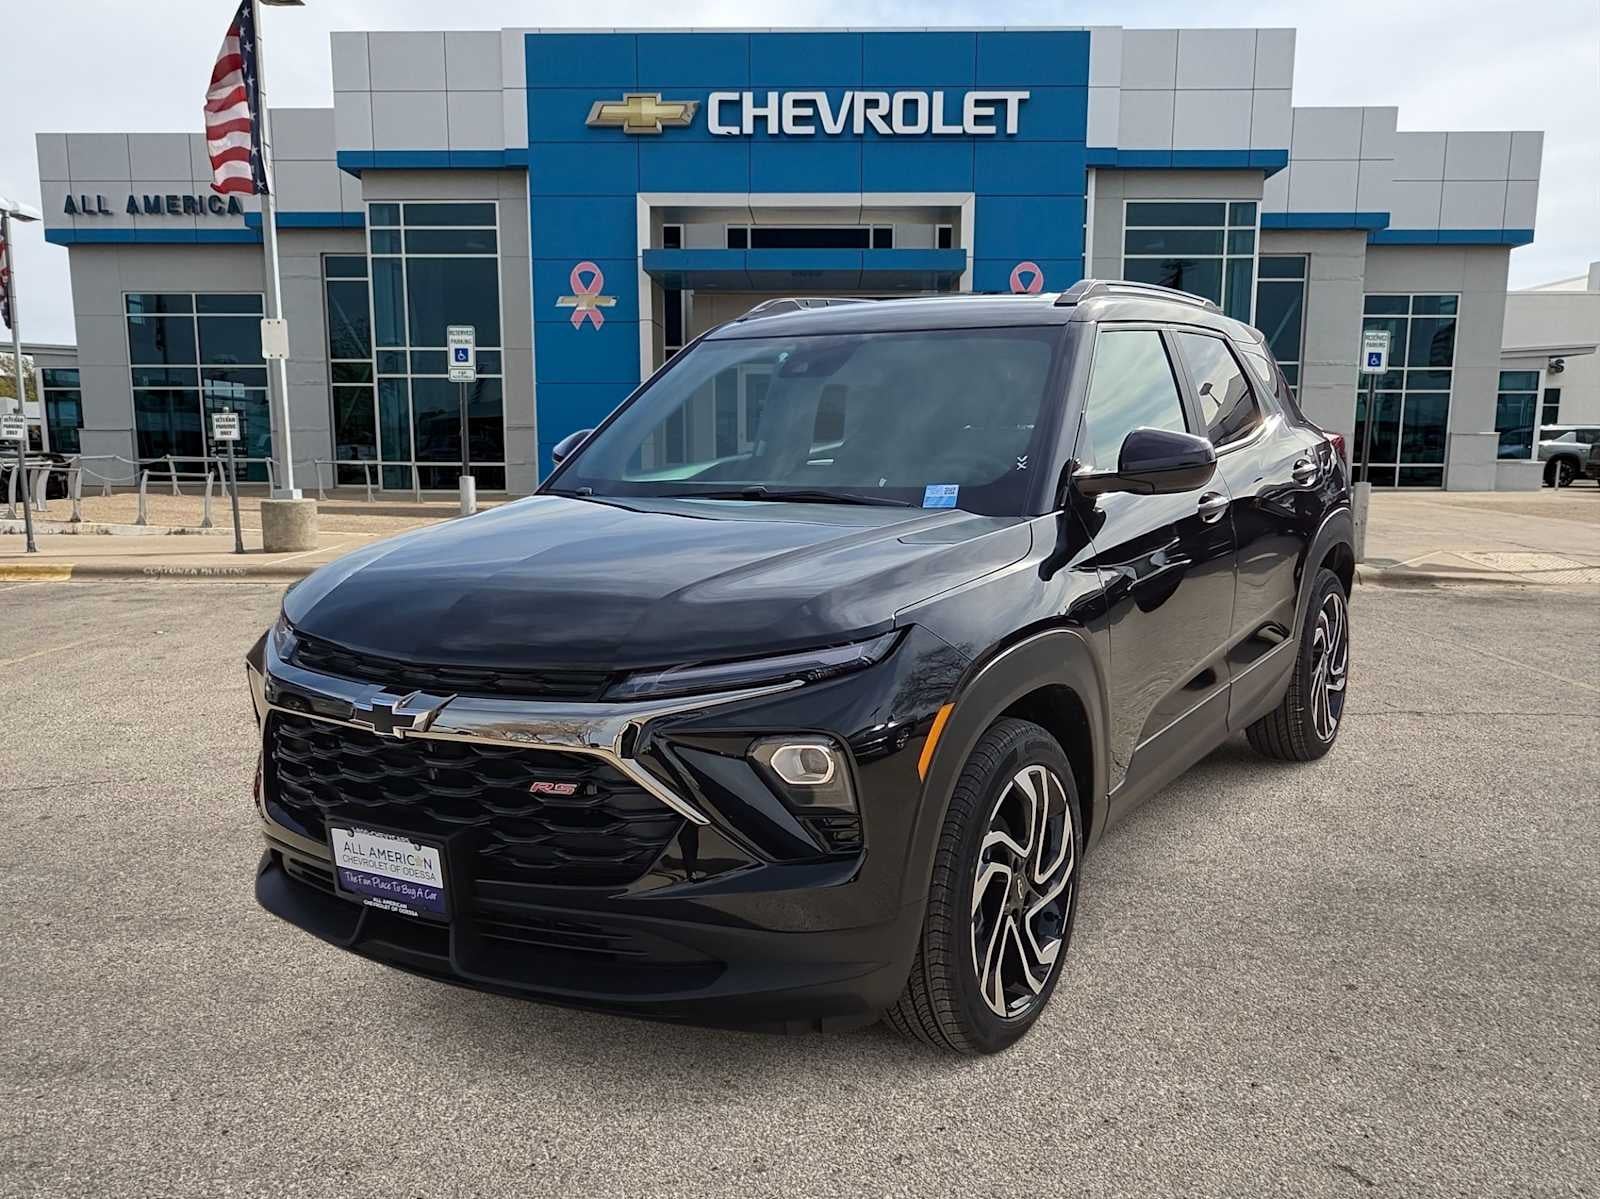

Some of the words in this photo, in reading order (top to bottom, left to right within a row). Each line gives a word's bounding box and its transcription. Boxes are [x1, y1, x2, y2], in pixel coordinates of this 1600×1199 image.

[708, 91, 1030, 135] CHEVROLET
[64, 195, 113, 215] ALL
[529, 782, 578, 795] RS
[343, 841, 365, 856] ALL
[343, 854, 388, 871] CHEVROLET
[391, 864, 401, 872] OF
[403, 866, 436, 881] ODESSA
[345, 871, 358, 884] The
[372, 877, 392, 890] Place
[392, 881, 401, 892] To
[402, 885, 417, 899] Buy
[417, 888, 424, 898] A
[424, 889, 438, 900] Car
